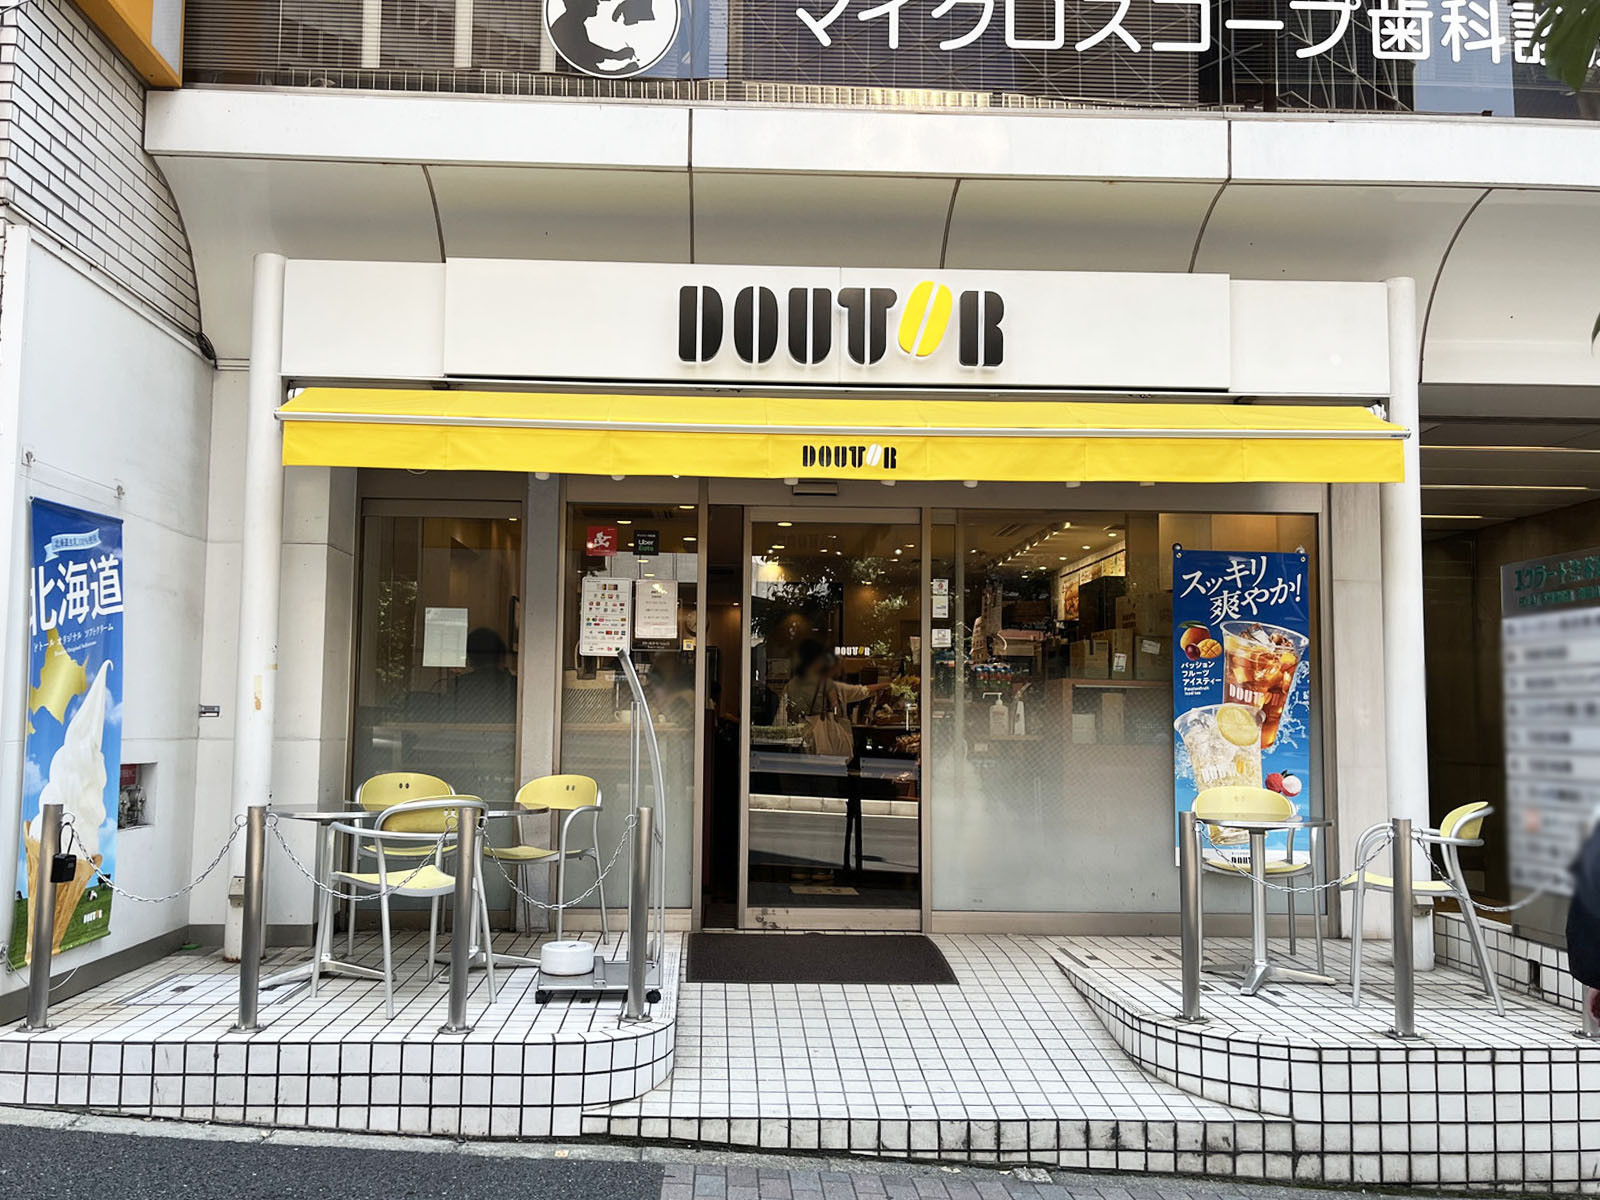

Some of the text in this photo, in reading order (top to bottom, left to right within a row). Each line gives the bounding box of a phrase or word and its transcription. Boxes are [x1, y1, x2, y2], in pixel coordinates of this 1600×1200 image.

[678, 280, 1005, 367] DOUTOR
[802, 443, 897, 469] DOUTOR
[1180, 556, 1267, 598] スッキリ
[30, 553, 123, 636] 北海道
[834, 645, 871, 657] DOUTOR
[1181, 669, 1210, 678] フルーツ
[1182, 677, 1222, 686] アイスティー
